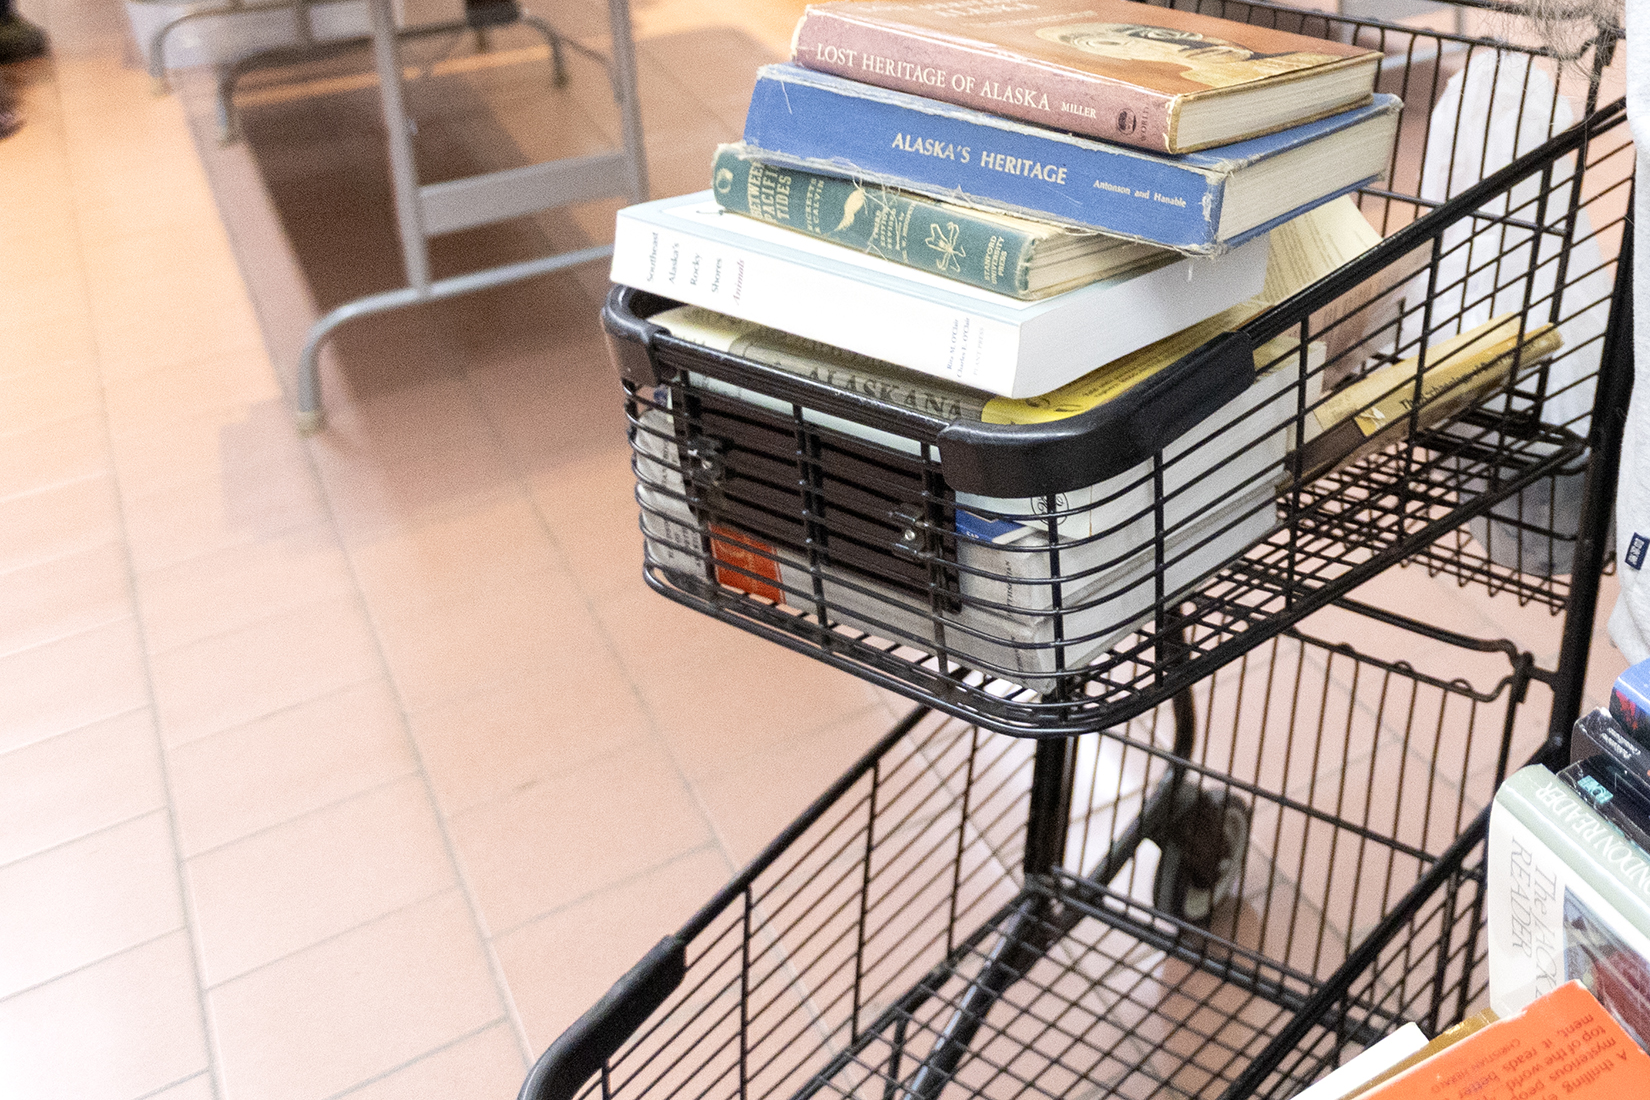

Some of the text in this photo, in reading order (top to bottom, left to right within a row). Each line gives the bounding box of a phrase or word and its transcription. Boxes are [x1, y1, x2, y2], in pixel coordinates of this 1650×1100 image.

[817, 42, 1097, 118] LOST HERITAGE OF ALASKA MILLER
[892, 132, 1187, 208] ALASKA'S HERITAGE Antonson and Hanable
[776, 175, 792, 220] TIDES
[647, 231, 658, 283] Southeast
[668, 242, 680, 284] Alaska's
[690, 253, 702, 285] Rocky
[711, 258, 723, 293] Shores
[984, 235, 997, 281] STANFORD
[991, 236, 1005, 284] UNIVERSITY
[998, 250, 1007, 276] PRESS
[733, 259, 745, 305] Animals
[1530, 775, 1605, 845] READER
[1510, 835, 1533, 959] READER
[1534, 866, 1557, 915] The
[1503, 1021, 1606, 1090] top of the world
[1507, 1044, 1537, 1068] reads
[1546, 1034, 1617, 1084] mysterious
[1559, 1047, 1630, 1094] A thrilling
